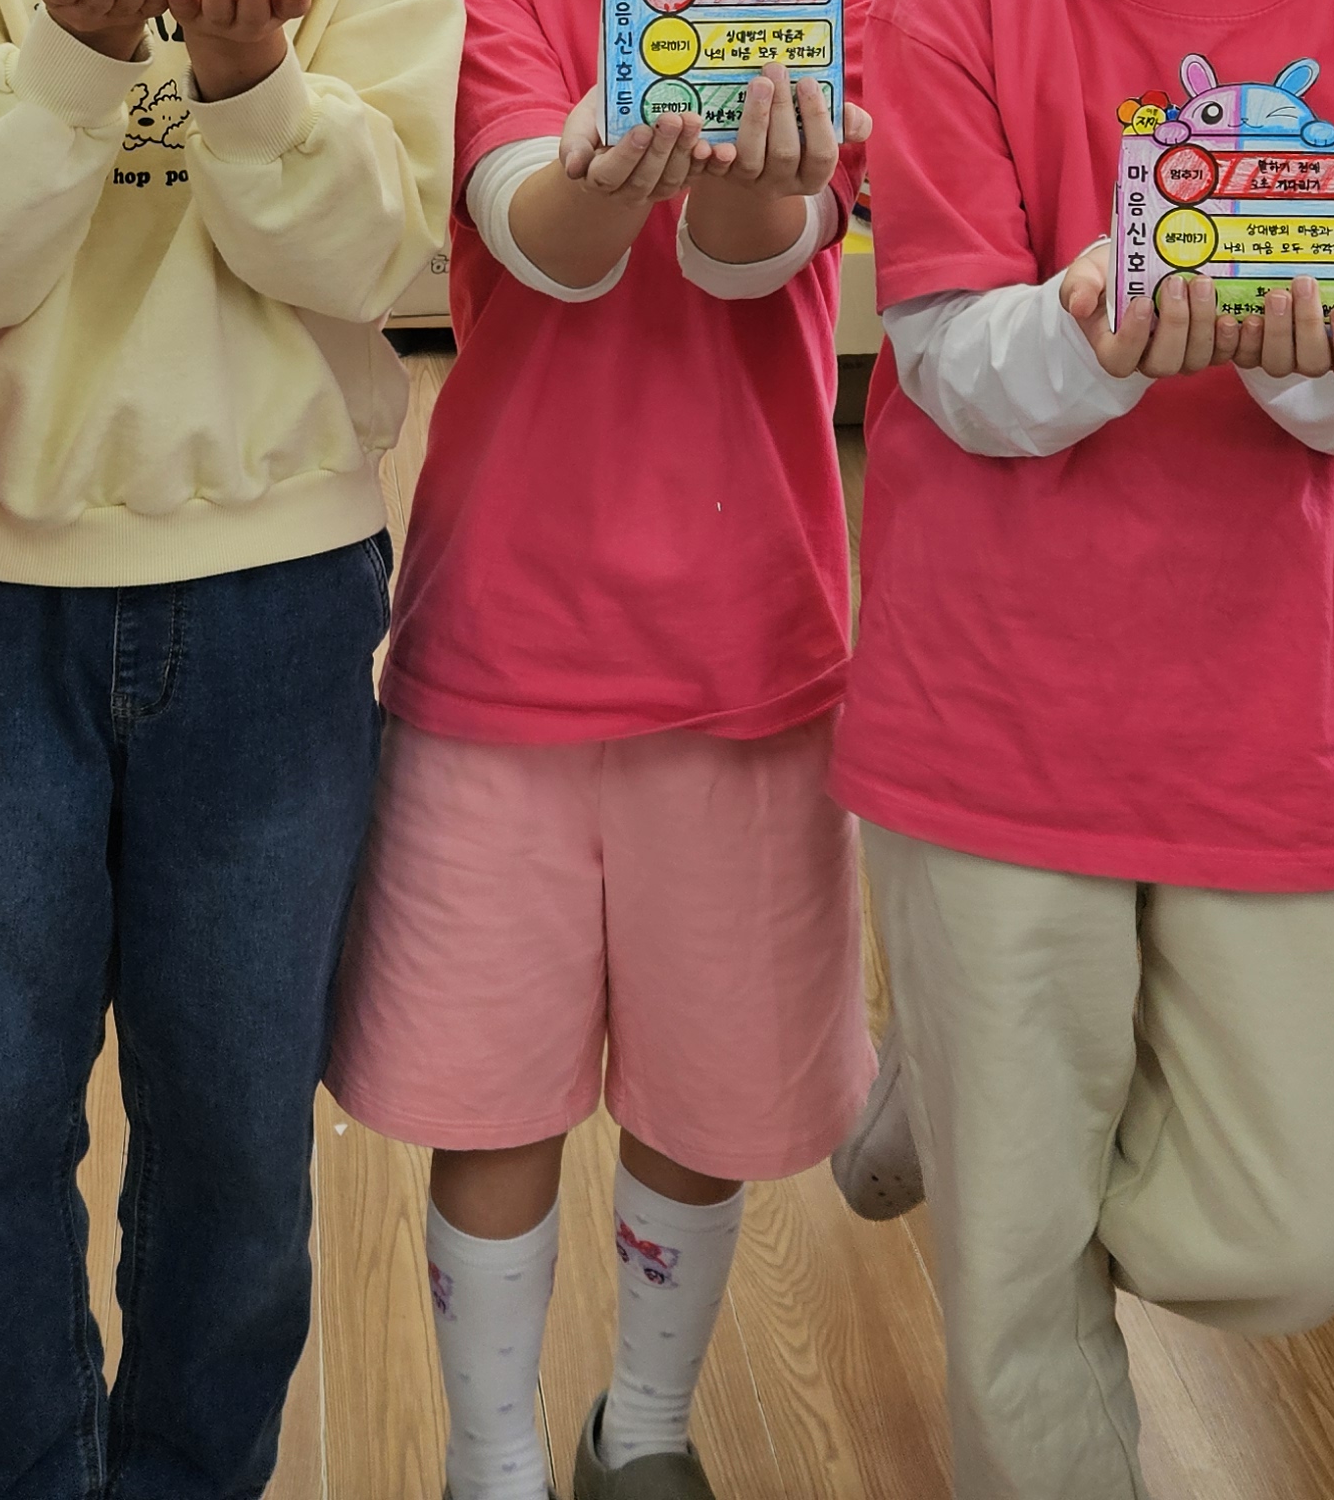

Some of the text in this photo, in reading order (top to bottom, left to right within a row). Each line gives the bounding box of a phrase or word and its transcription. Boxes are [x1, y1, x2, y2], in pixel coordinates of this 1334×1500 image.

[651, 40, 690, 52] 생각하기
[113, 168, 151, 187] hop
[1170, 168, 1204, 181] 멈추기
[1165, 232, 1207, 244] 생각하기
